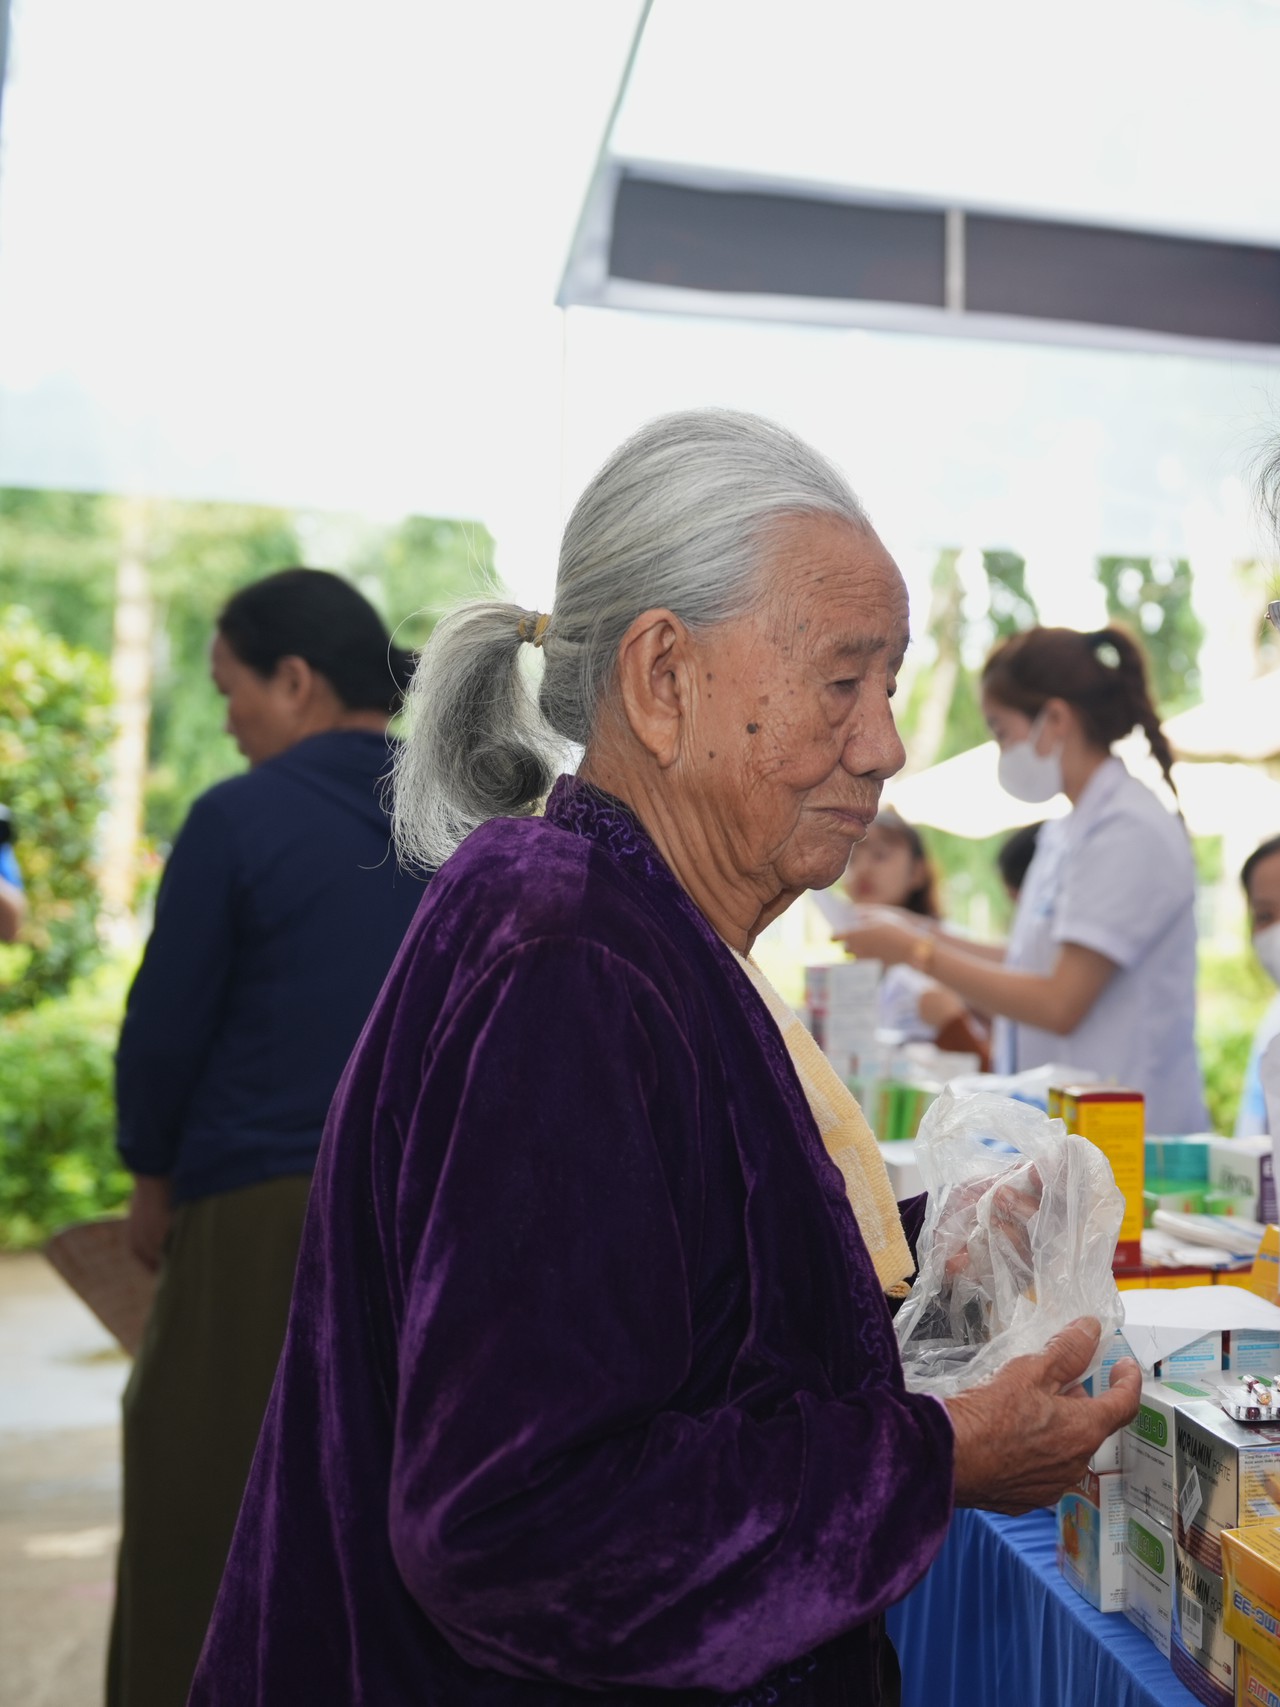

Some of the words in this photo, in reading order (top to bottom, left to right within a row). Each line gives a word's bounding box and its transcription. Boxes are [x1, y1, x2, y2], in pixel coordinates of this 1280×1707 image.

[1177, 1426, 1213, 1470] MORIAMIN
[1211, 1460, 1231, 1483] FORTE
[1176, 1558, 1210, 1604] MORIAMIN
